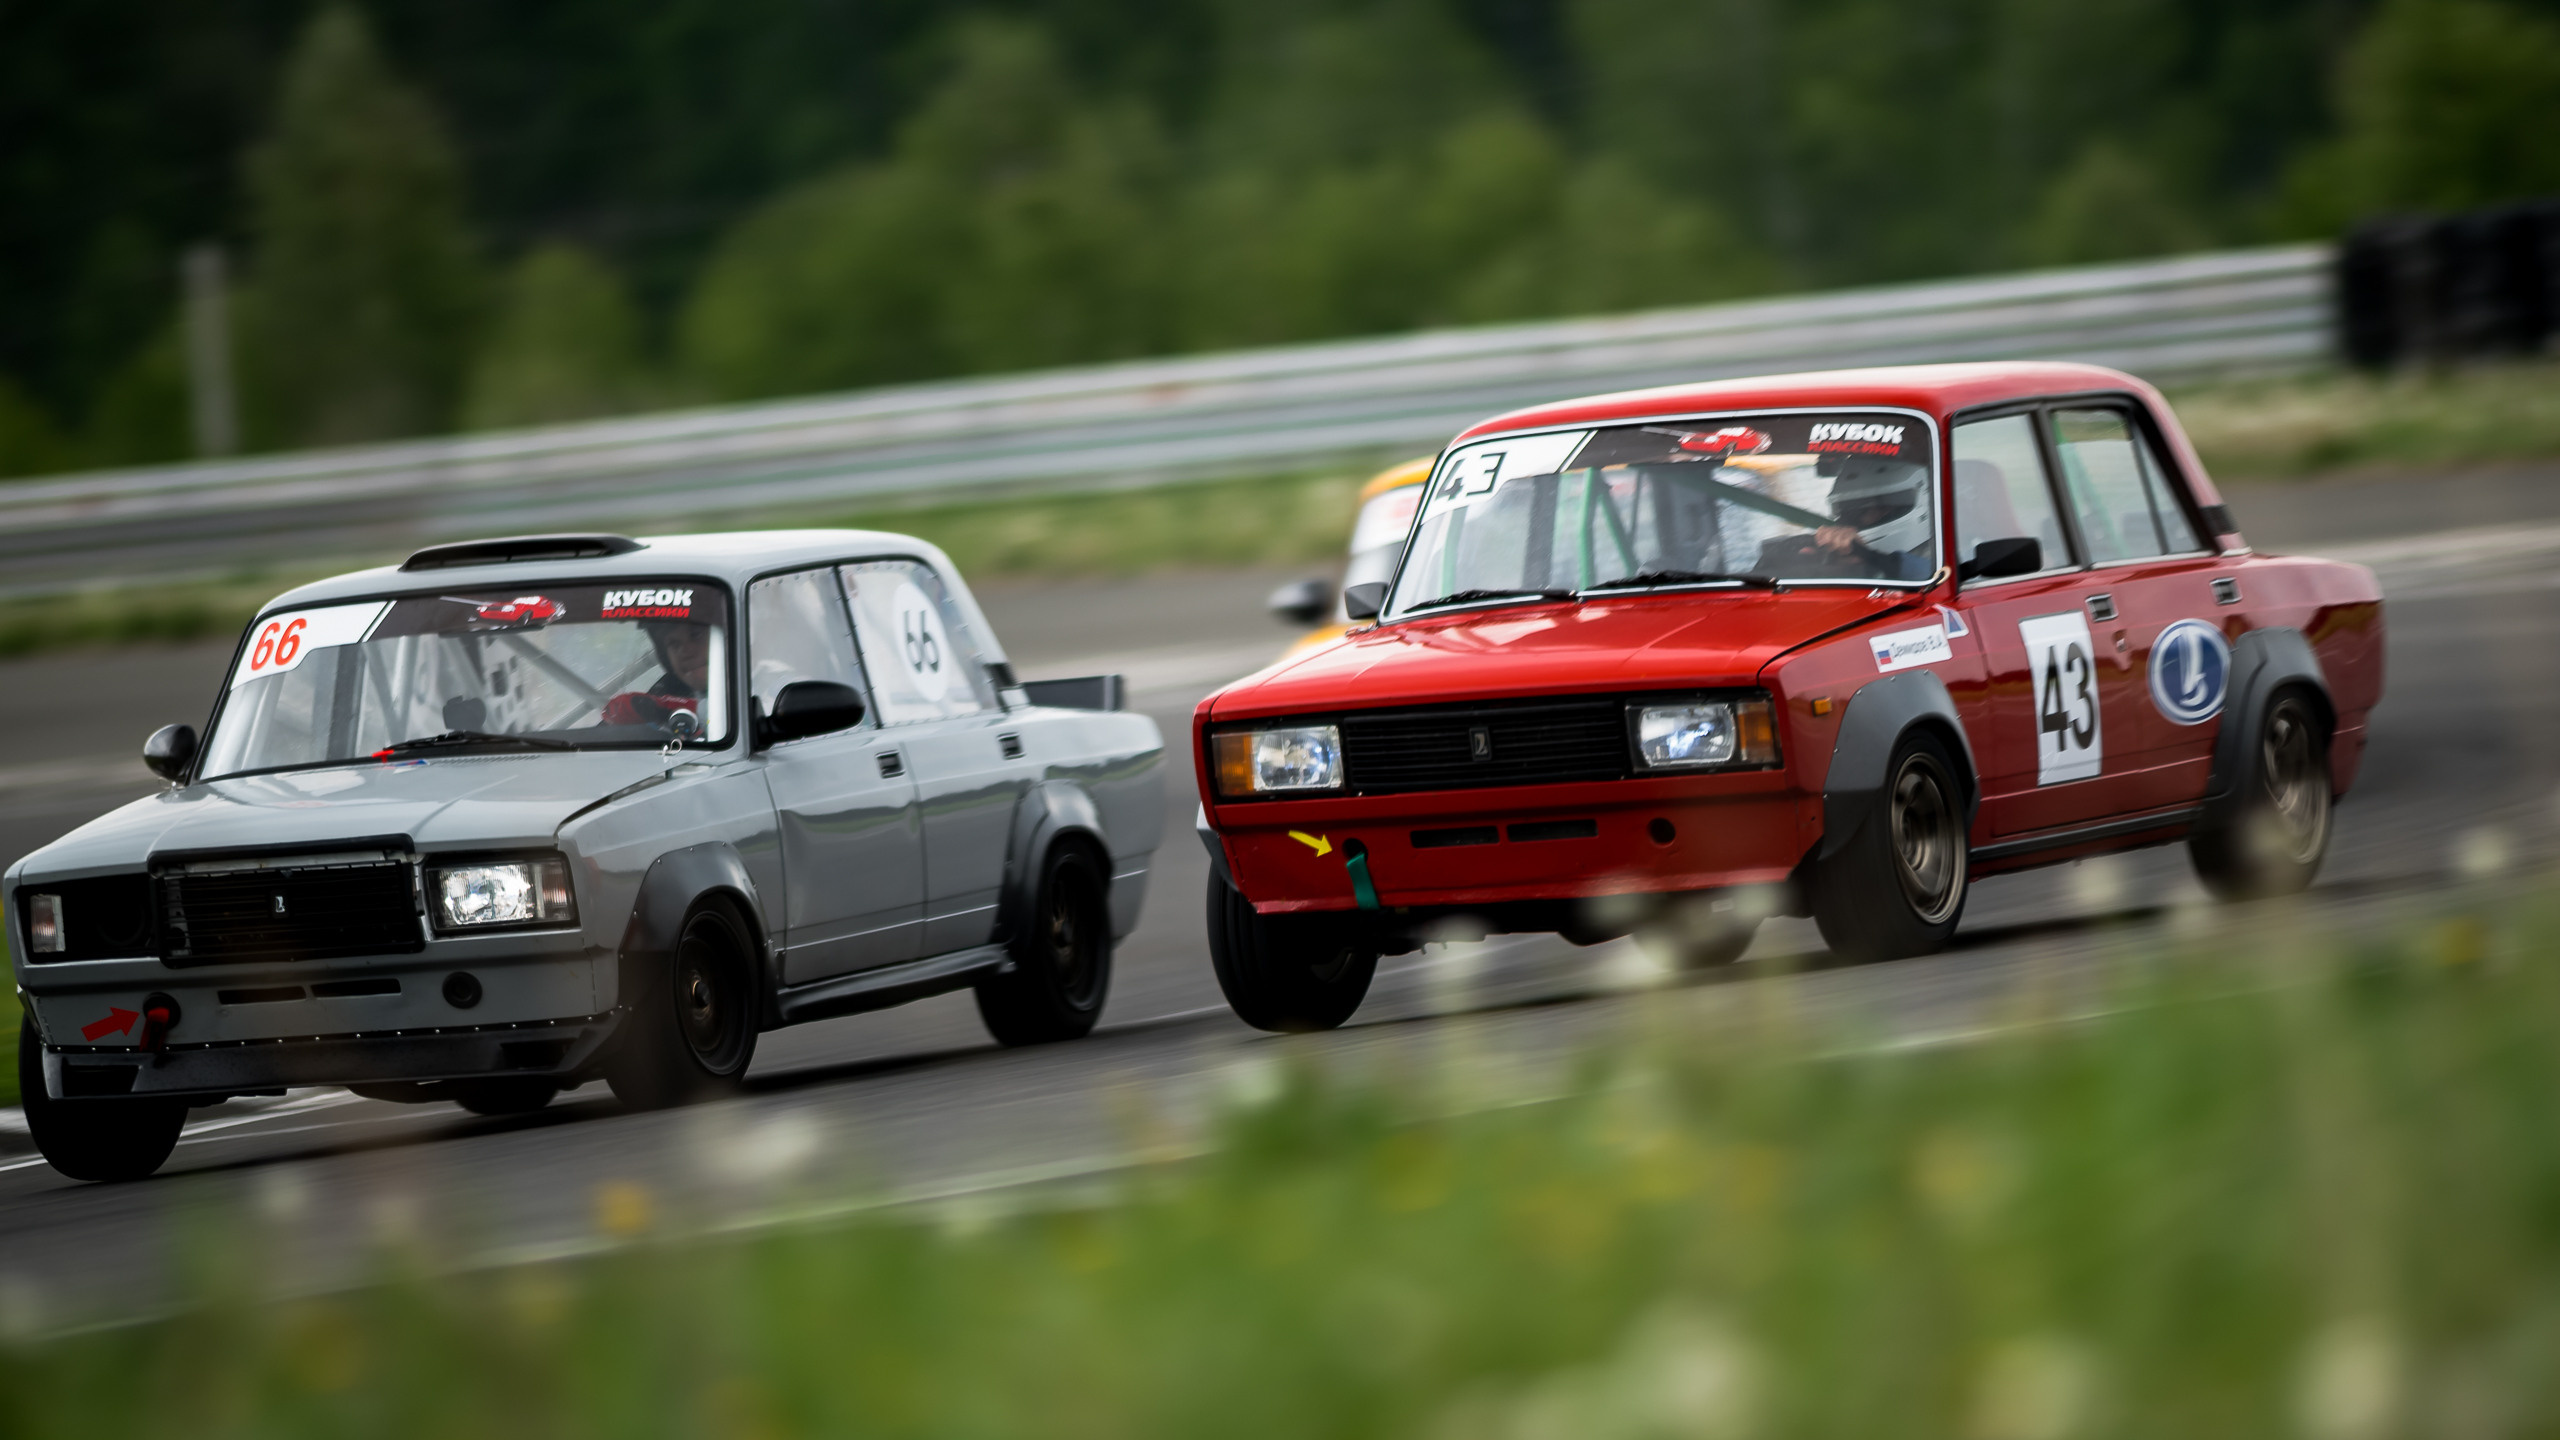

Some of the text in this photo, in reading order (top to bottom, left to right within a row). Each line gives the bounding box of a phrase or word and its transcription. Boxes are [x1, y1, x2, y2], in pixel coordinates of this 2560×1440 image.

[1806, 440, 1900, 457] КЛАССИКИ
[1809, 423, 1905, 444] КУБОК
[1435, 452, 1508, 501] 43
[602, 607, 690, 618] КЛАССИКИ
[603, 589, 693, 609] КУБОК
[251, 618, 307, 671] 66
[903, 609, 940, 674] 66
[2042, 642, 2096, 752] 43
